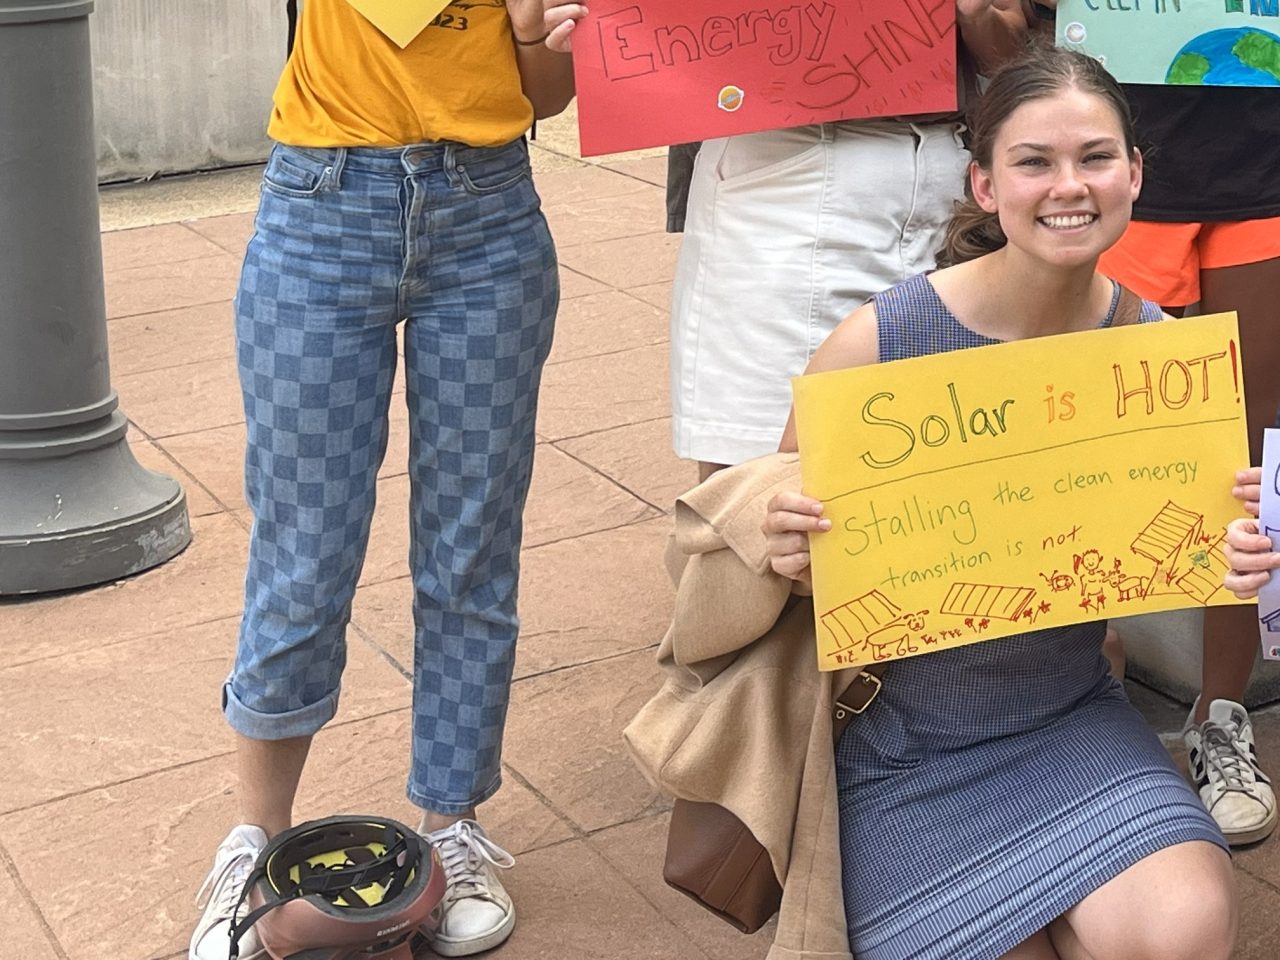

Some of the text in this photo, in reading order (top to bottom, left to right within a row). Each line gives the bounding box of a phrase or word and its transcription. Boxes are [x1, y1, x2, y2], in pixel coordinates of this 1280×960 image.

[596, 1, 837, 82] Energy
[858, 338, 1242, 470] Solar is HOT!
[843, 460, 1199, 557] Stalling the clean energy
[881, 550, 993, 591] transition
[1006, 539, 1025, 558] is
